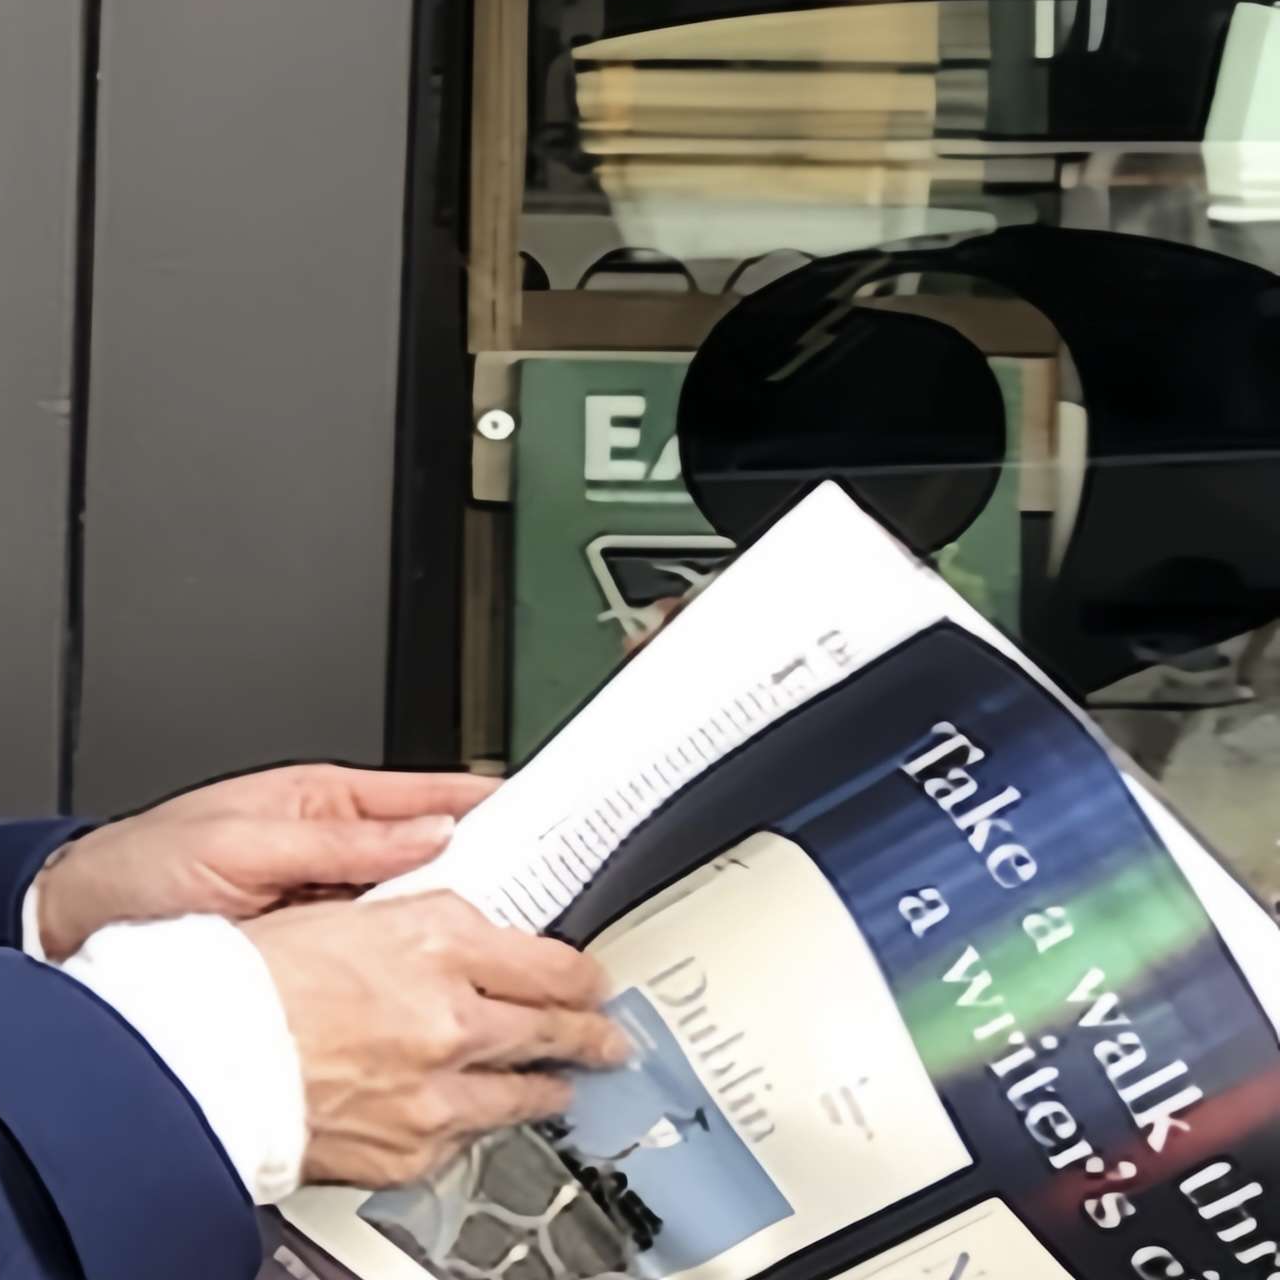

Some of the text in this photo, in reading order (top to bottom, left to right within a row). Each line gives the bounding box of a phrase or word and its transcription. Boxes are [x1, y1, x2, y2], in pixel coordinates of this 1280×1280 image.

[898, 887, 950, 938] a
[942, 945, 1137, 1228] writer's
[900, 721, 1038, 888] Take
[1023, 905, 1073, 953] a
[1067, 967, 1204, 1153] walk
